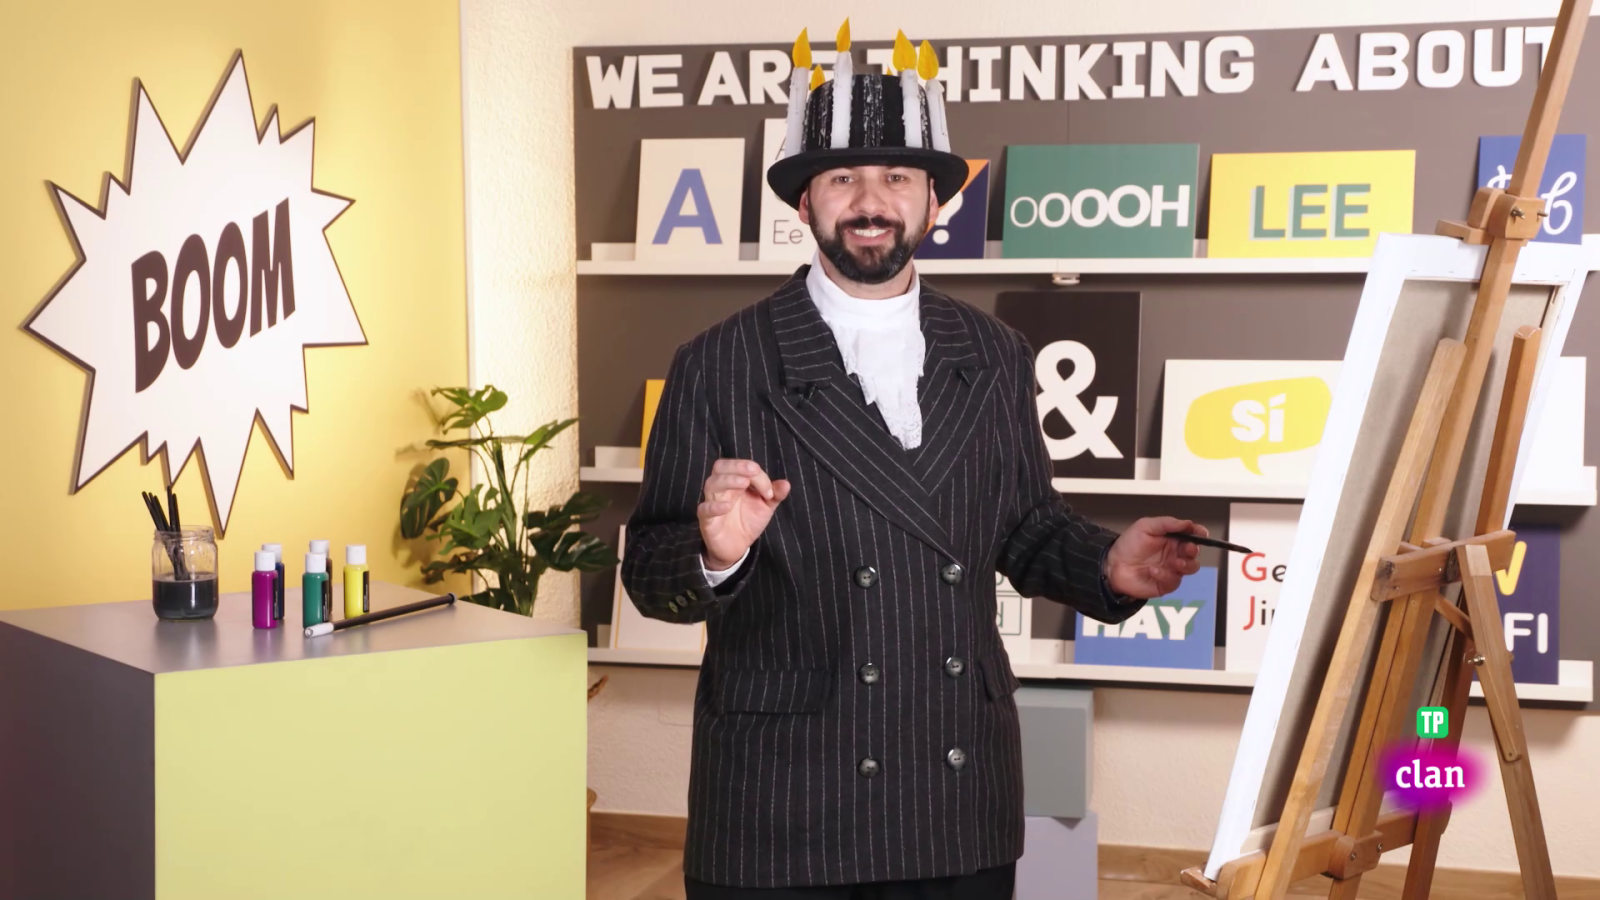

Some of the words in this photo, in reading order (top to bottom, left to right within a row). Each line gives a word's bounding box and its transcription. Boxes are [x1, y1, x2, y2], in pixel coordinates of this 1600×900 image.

[586, 54, 683, 109] WE
[652, 168, 723, 244] A
[773, 219, 803, 244] Ee
[1250, 183, 1371, 240] LEE
[131, 196, 296, 394] BOOM
[1035, 340, 1124, 460] &
[1243, 595, 1275, 631] Ji
